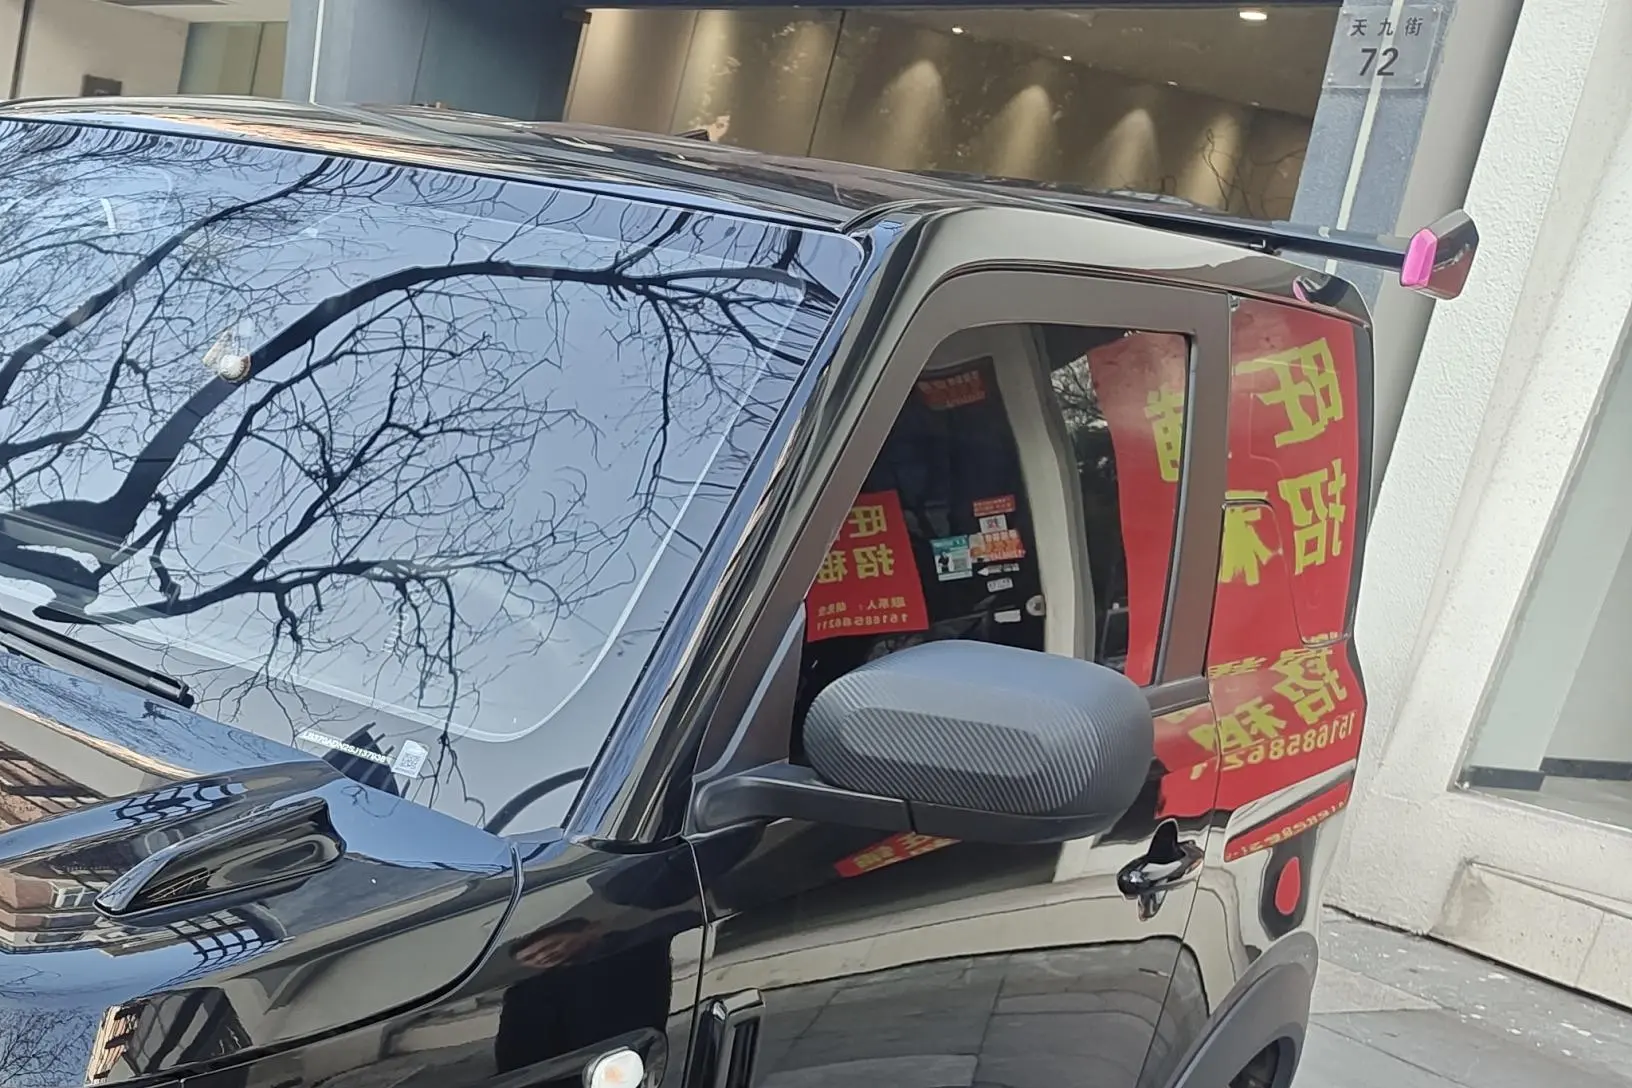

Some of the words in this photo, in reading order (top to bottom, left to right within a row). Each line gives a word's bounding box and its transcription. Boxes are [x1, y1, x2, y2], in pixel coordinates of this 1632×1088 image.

[1350, 17, 1424, 36] 天九街
[1359, 47, 1399, 76] 72
